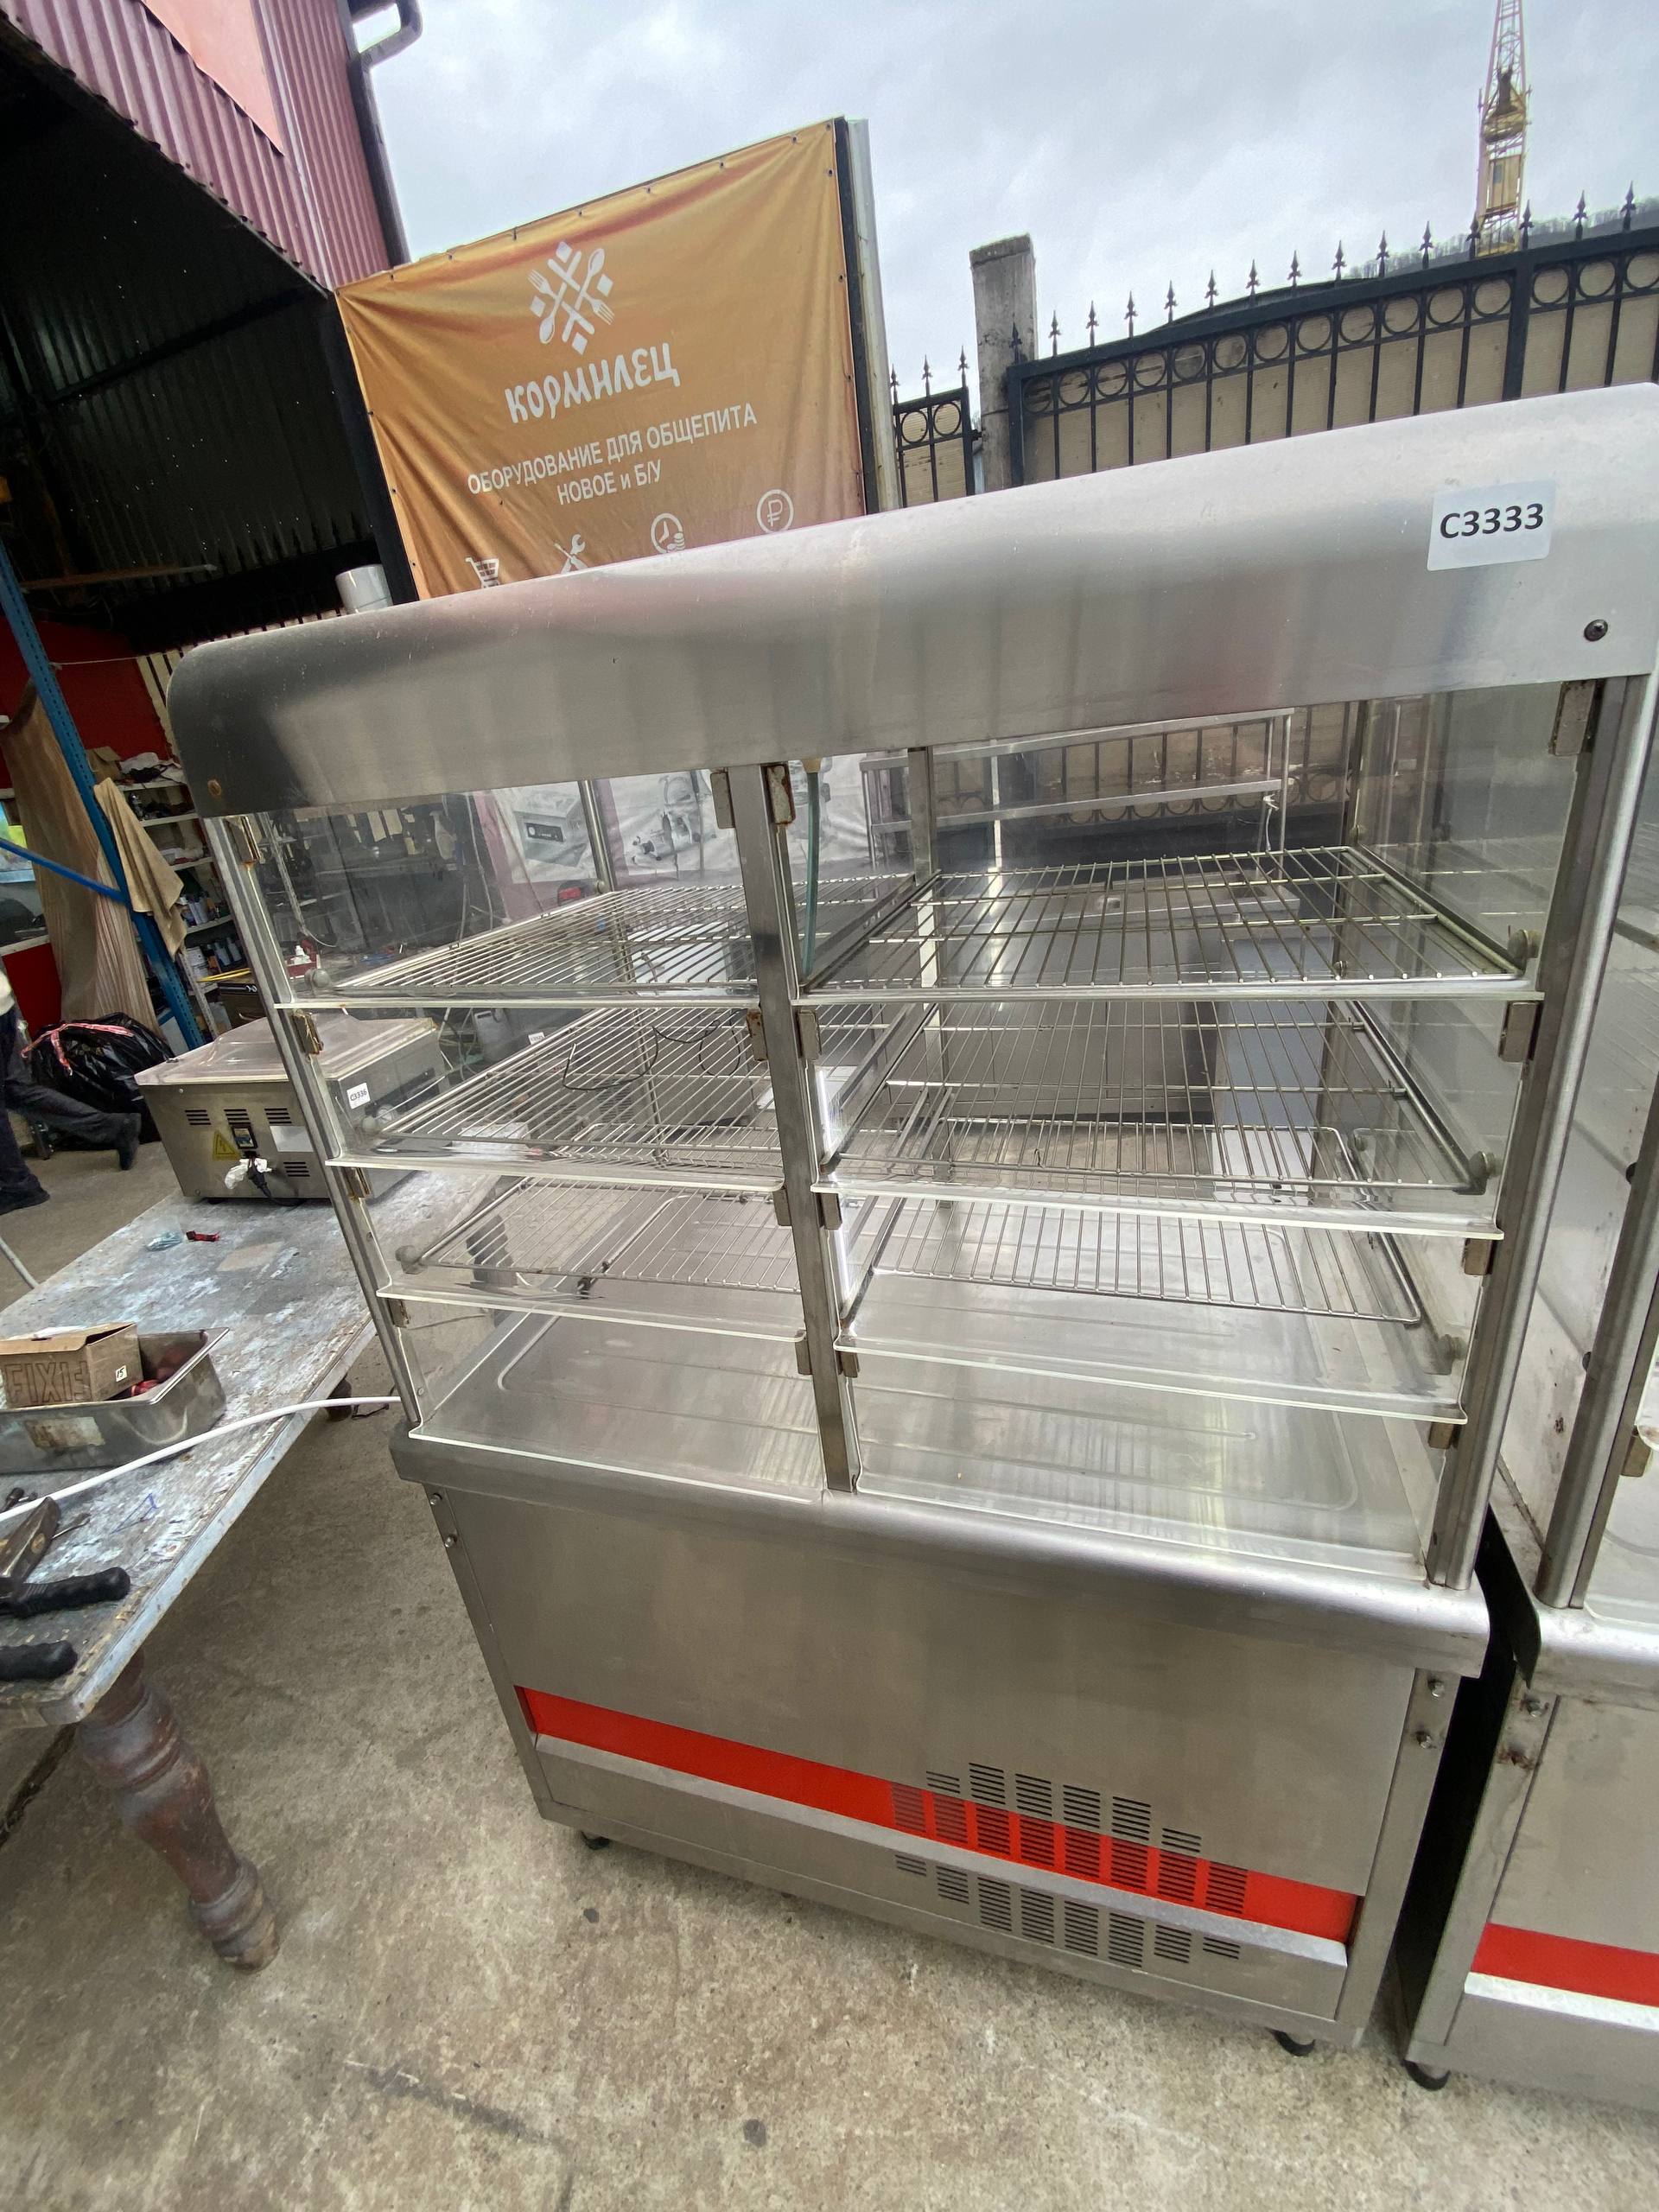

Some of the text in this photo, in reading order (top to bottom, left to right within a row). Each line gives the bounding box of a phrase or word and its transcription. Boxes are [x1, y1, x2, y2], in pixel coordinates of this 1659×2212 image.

[505, 342, 681, 423] КОРМИЛЕЦ
[467, 403, 757, 494] ОБОРУДОВАНИЕ ДЛЯ ОБЩЕПИТА
[557, 471, 617, 505] НОВОЕ
[634, 459, 661, 486] Б/У
